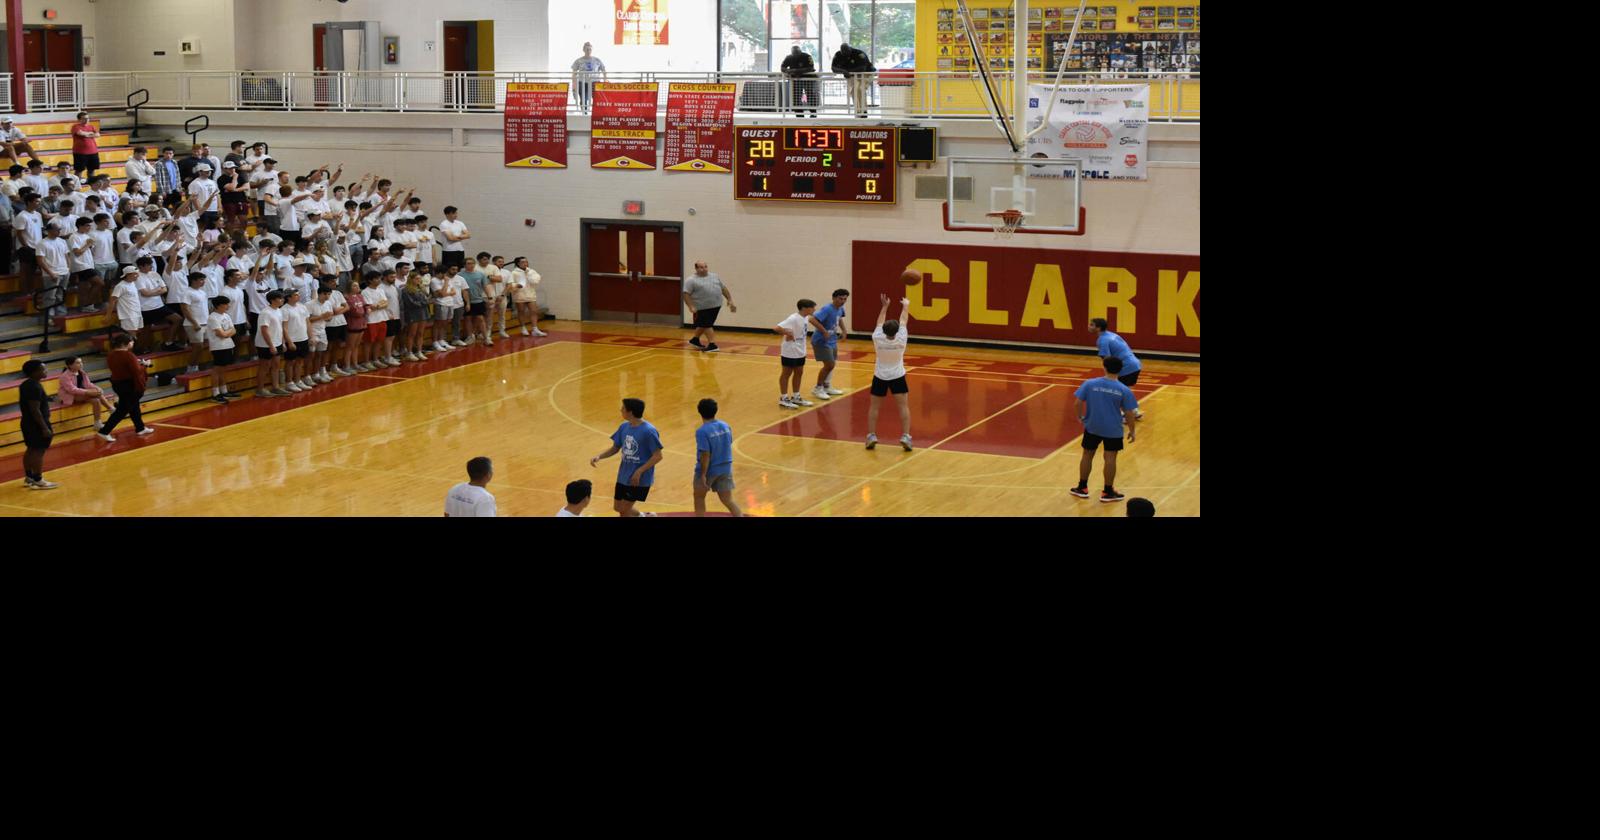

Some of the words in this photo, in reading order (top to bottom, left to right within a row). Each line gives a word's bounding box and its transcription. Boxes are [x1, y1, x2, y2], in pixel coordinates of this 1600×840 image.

[1051, 33, 1107, 41] GLAIATORS
[742, 129, 778, 138] GUEST
[795, 129, 841, 148] 17:37
[849, 130, 888, 140] GLADIATORS
[750, 140, 774, 158] 28
[858, 141, 884, 160] 25
[785, 155, 817, 163] PERIOD
[822, 153, 832, 167] 2
[1063, 169, 1109, 179] MPOLE
[762, 177, 767, 191] 1
[865, 179, 876, 194] 0
